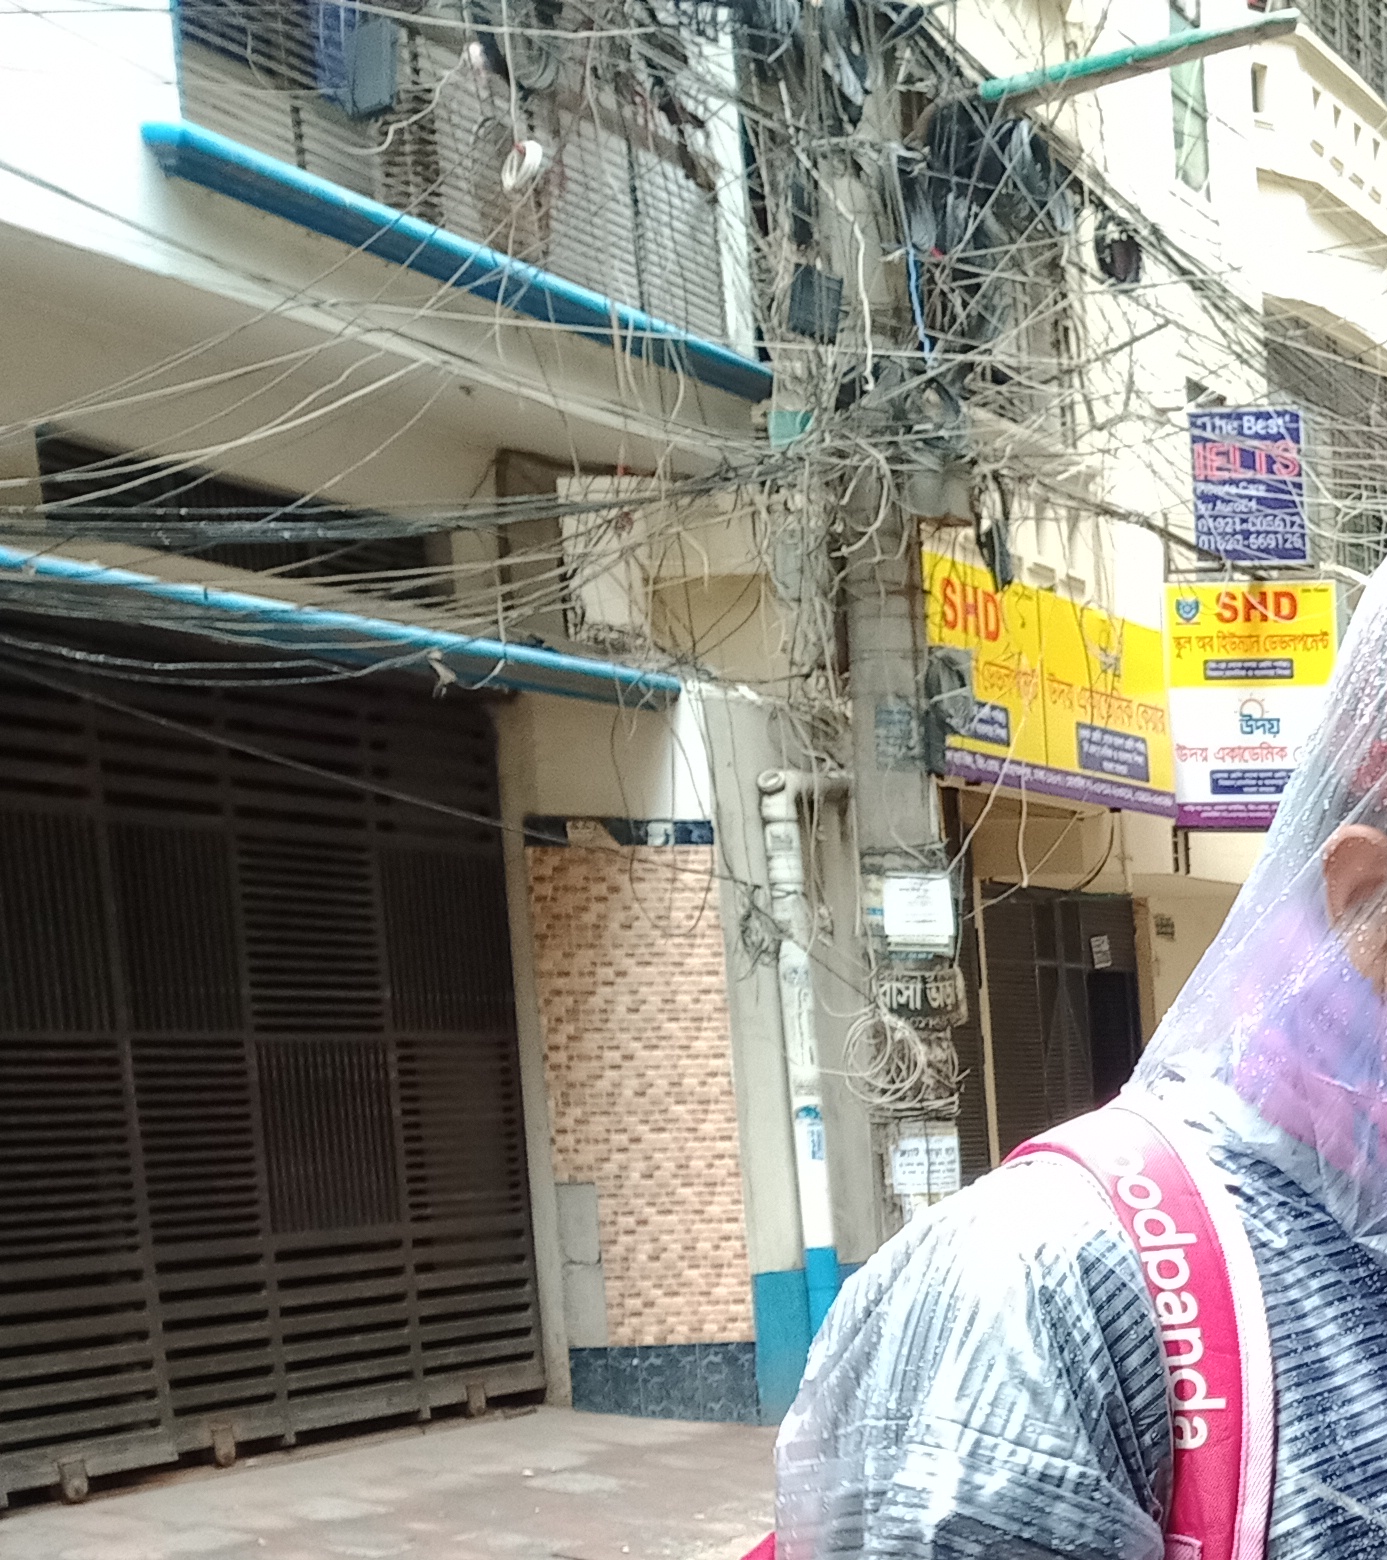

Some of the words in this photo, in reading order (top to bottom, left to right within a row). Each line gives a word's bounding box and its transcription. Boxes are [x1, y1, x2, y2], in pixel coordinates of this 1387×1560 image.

[1193, 439, 1301, 481] IELTS
[939, 576, 1001, 643] SHD
[1215, 591, 1298, 623] SHD
[1238, 713, 1281, 738] উদয়
[1175, 742, 1209, 763] উদয়
[1213, 741, 1289, 764] একাডেমিক
